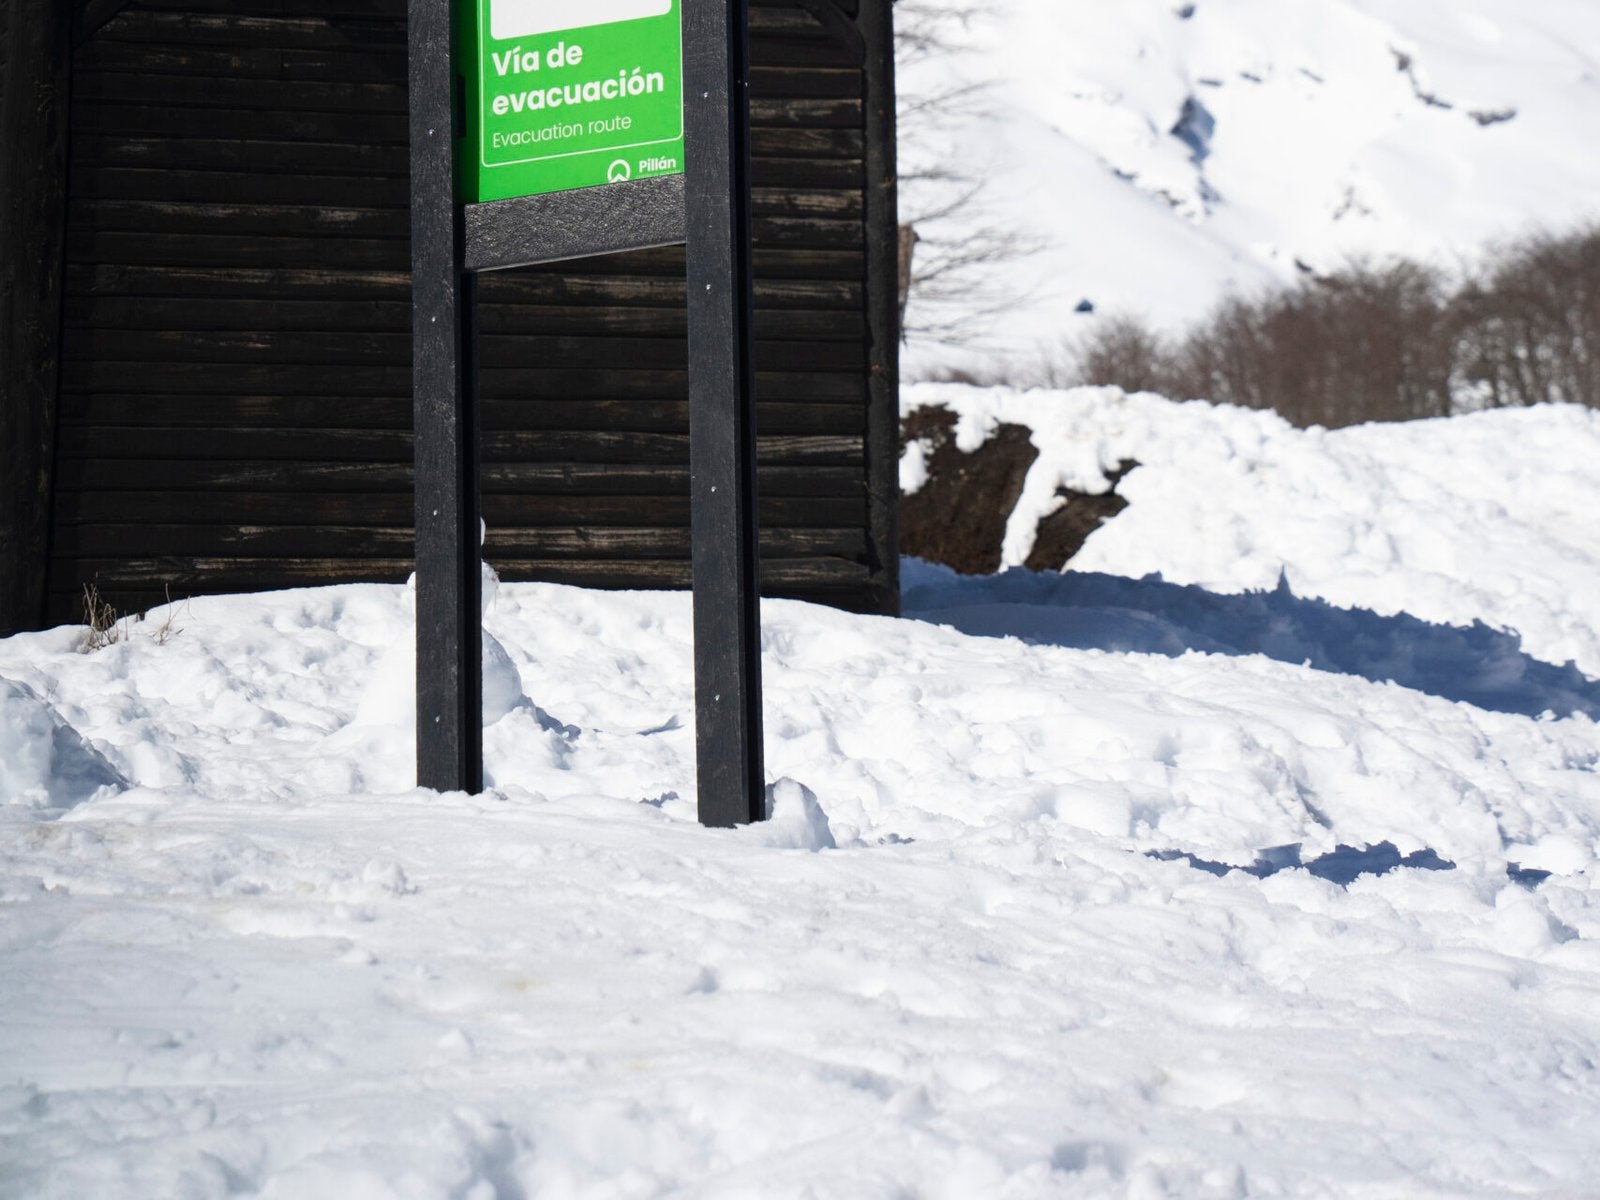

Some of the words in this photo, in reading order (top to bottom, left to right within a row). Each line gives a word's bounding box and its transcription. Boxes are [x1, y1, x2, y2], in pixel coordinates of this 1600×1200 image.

[492, 46, 540, 76] Vía
[546, 42, 583, 68] de
[492, 67, 664, 115] evacuación
[493, 123, 583, 148] Evacuation
[588, 115, 632, 135] route
[639, 156, 676, 173] Pillán
